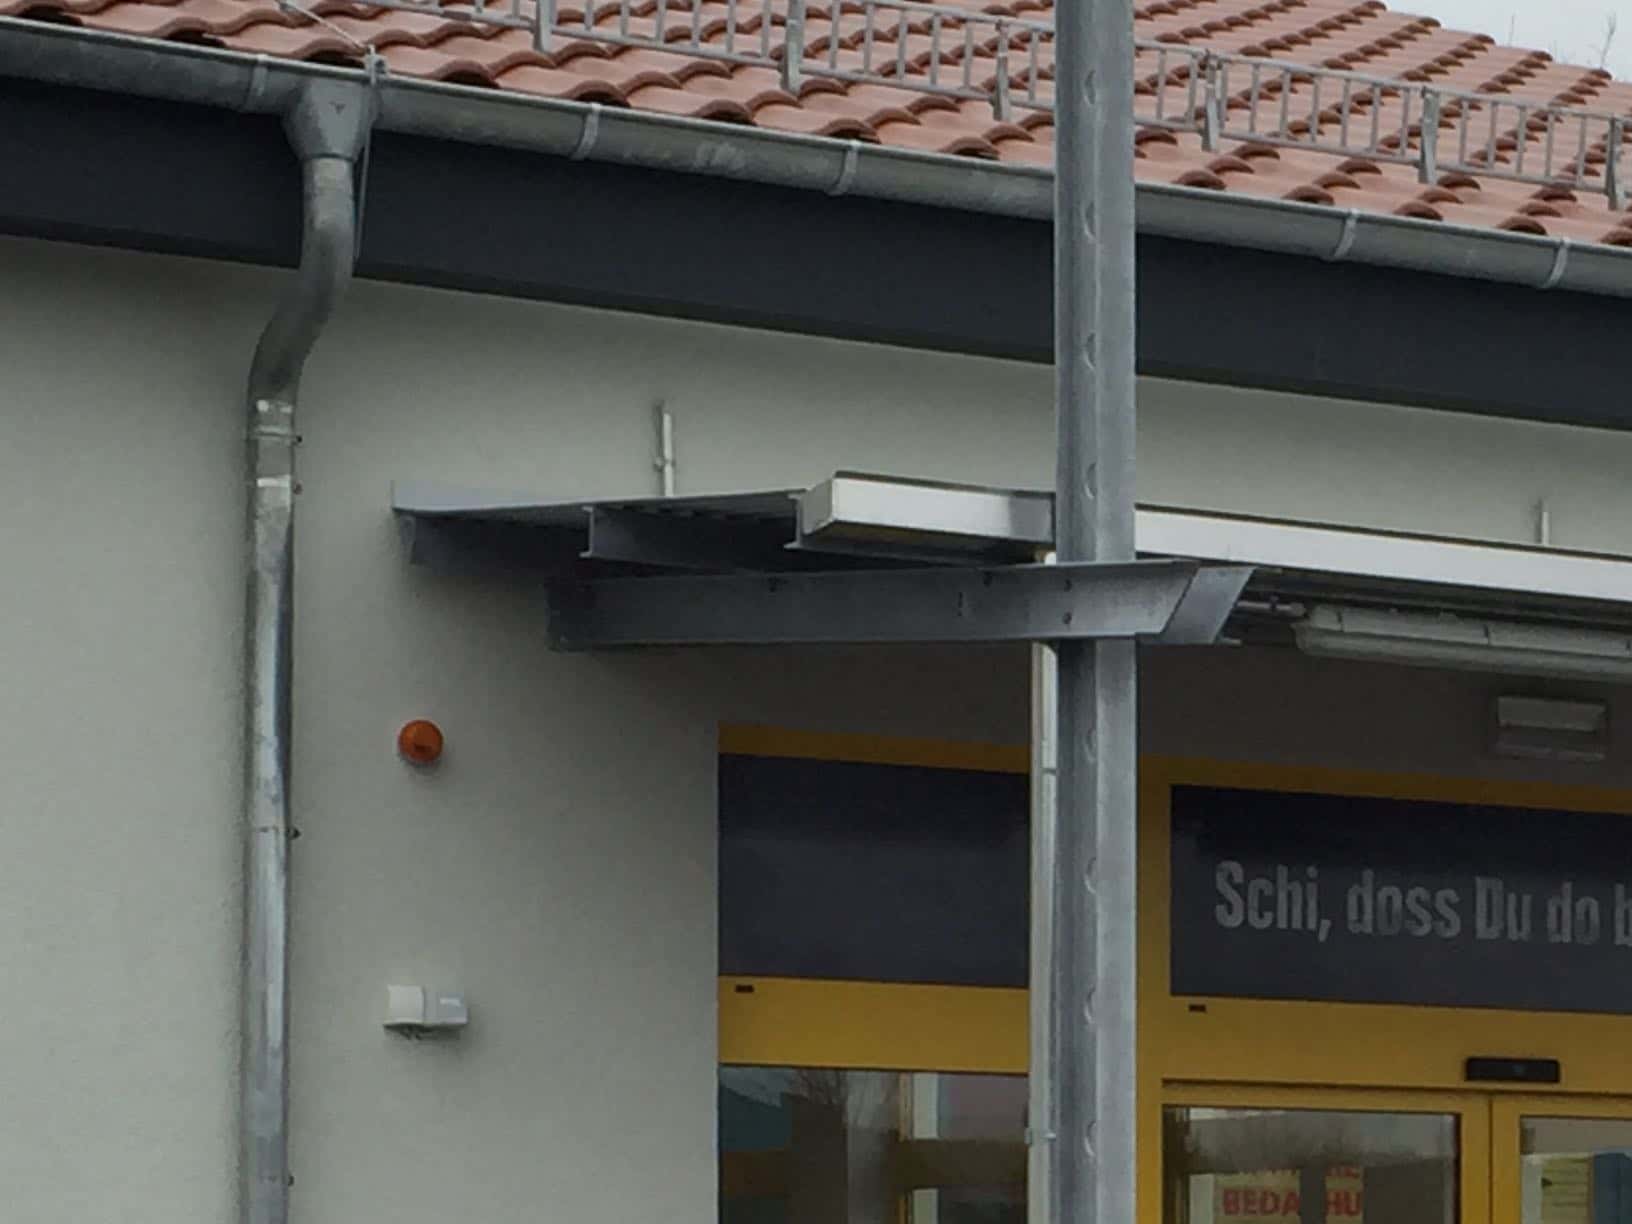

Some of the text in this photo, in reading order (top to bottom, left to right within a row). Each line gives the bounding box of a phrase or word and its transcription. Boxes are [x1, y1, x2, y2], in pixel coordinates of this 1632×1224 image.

[1215, 860, 1331, 943] Schi,
[1474, 875, 1533, 941] Du
[1547, 881, 1600, 944] do
